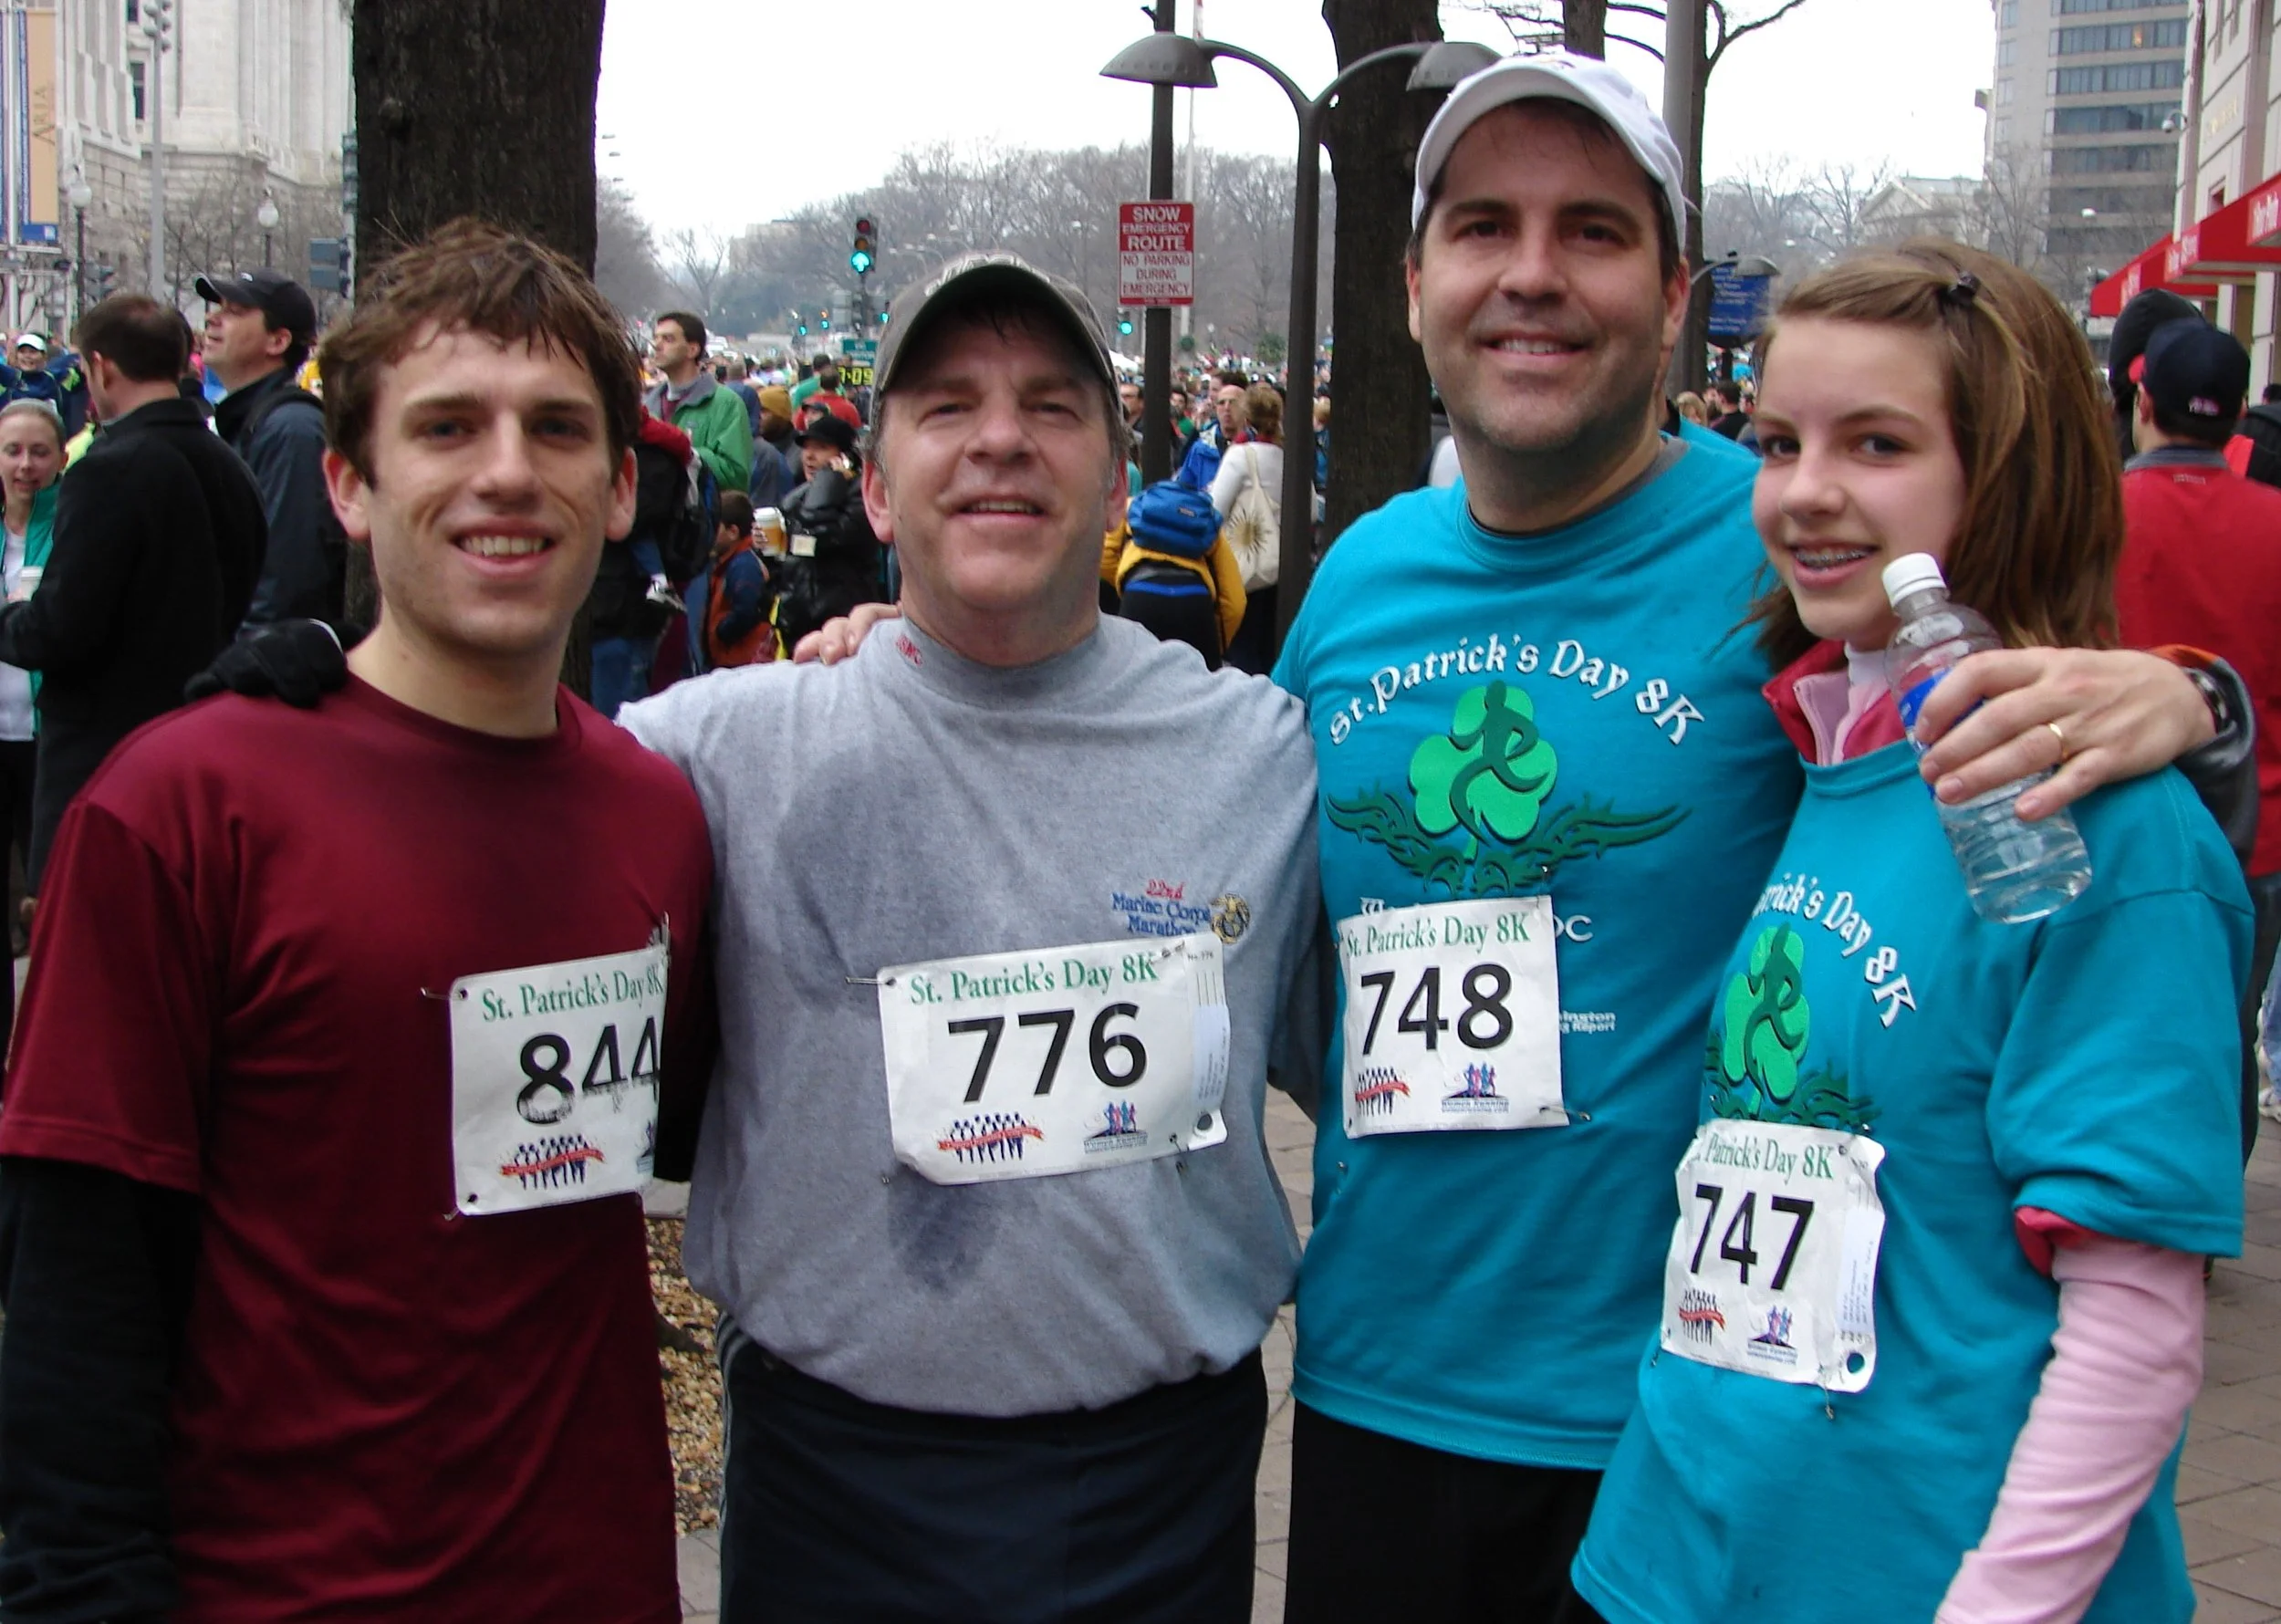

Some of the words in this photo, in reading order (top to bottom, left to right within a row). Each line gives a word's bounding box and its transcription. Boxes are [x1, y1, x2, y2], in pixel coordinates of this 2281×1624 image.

[1122, 223, 1191, 234] EMERGENCY
[1132, 206, 1181, 223] SNOW
[1123, 255, 1139, 265] NO
[1144, 255, 1190, 265] PARKING
[1128, 235, 1185, 251] ROUTE
[1123, 284, 1190, 294] EMERGENCY
[1136, 269, 1177, 280] DURING
[1548, 639, 1630, 700] Day
[1635, 677, 1705, 746] 8K
[1111, 891, 1162, 914] Marine
[1166, 900, 1211, 925] Corps
[1347, 931, 1362, 957] St.
[1367, 919, 1437, 955] Patrick's
[1443, 915, 1489, 953] Day
[1496, 912, 1531, 943] 8K
[911, 976, 943, 1005] St.
[951, 962, 1056, 1001] Patrick's
[1064, 959, 1113, 994] Day
[1121, 952, 1160, 984] 8K
[1821, 890, 1871, 957] Day
[1865, 945, 1916, 1029] 8K
[483, 988, 513, 1022] St.
[519, 973, 609, 1015] Patrick's
[613, 970, 646, 1008] Day
[646, 963, 665, 995] 8K
[1360, 963, 1515, 1057] 748
[516, 1015, 661, 1125] 844
[946, 1000, 1148, 1104] 776
[1764, 1139, 1797, 1185] Day
[1802, 1142, 1835, 1180] 8K
[1691, 1182, 1815, 1291] 747
